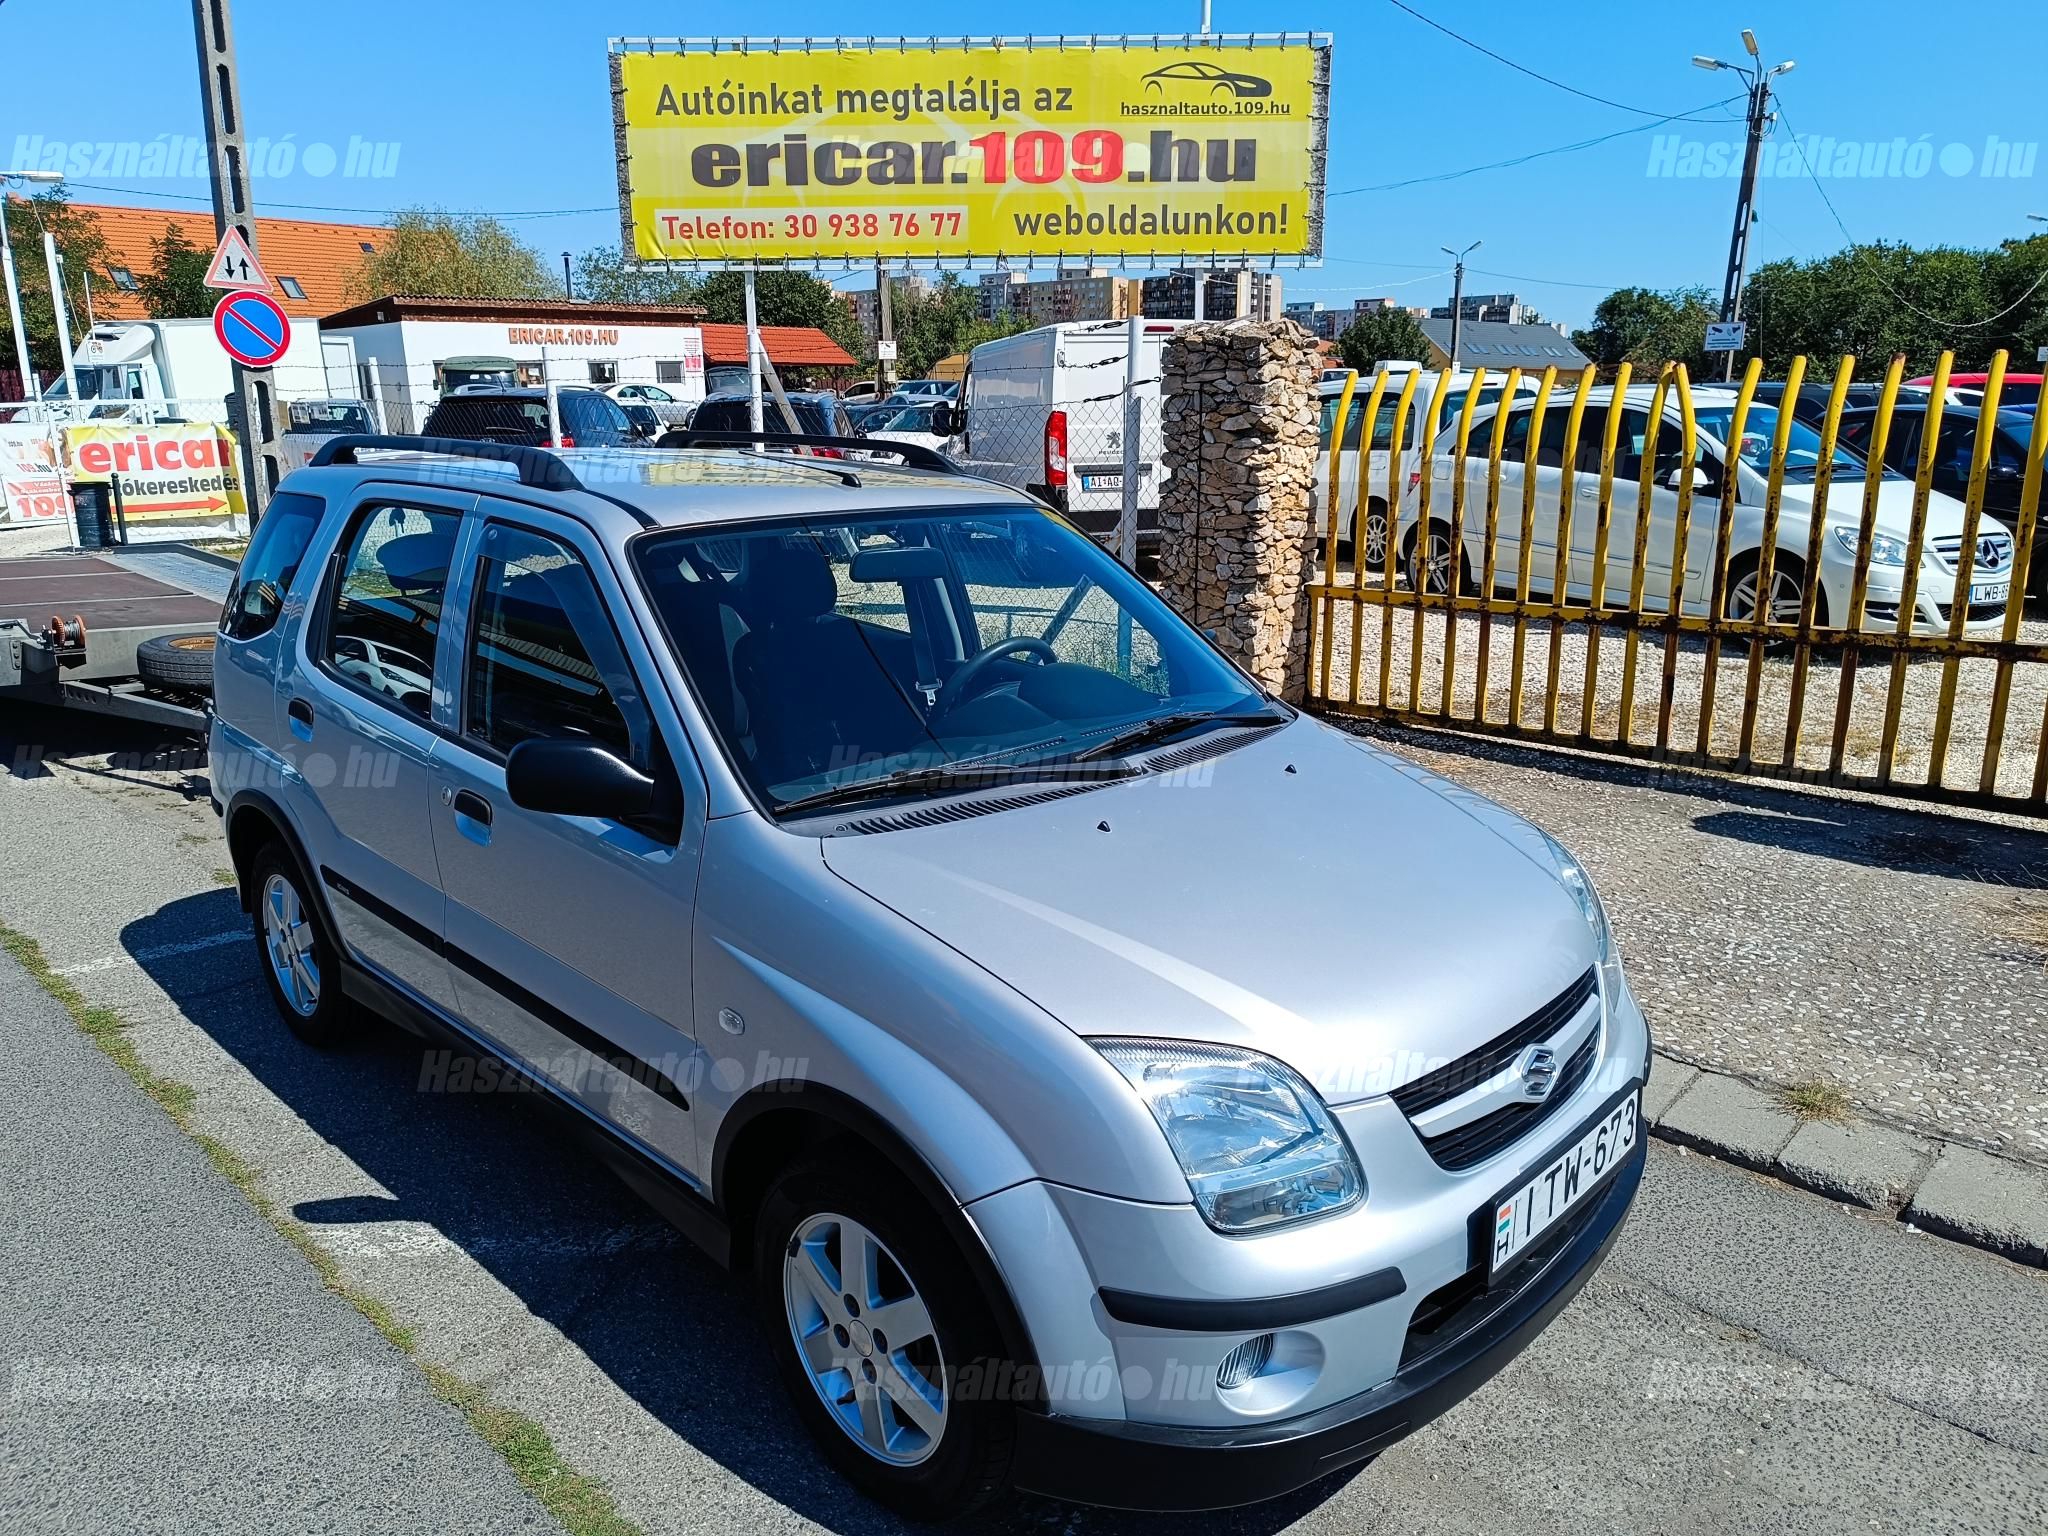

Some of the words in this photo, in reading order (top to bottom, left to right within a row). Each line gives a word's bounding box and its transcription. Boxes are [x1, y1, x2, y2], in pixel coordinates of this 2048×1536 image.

[656, 79, 823, 116] Autóinkat
[836, 75, 1020, 121] megtalálja
[1034, 87, 1073, 111] az
[1120, 101, 1291, 115] hasznaltauto.109.hu
[691, 130, 1257, 188] ericar.109.hu
[662, 215, 774, 240] Telefon:
[784, 214, 817, 238] 30
[828, 214, 879, 238] 938
[889, 213, 920, 237] 76
[930, 212, 962, 236] 77
[1014, 203, 1288, 236] weboldalunkon!
[508, 327, 619, 346] ERICAR.109.HU
[79, 435, 230, 473] ericar
[1526, 1098, 1635, 1238] ITW-673
[1496, 1231, 1510, 1264] H
